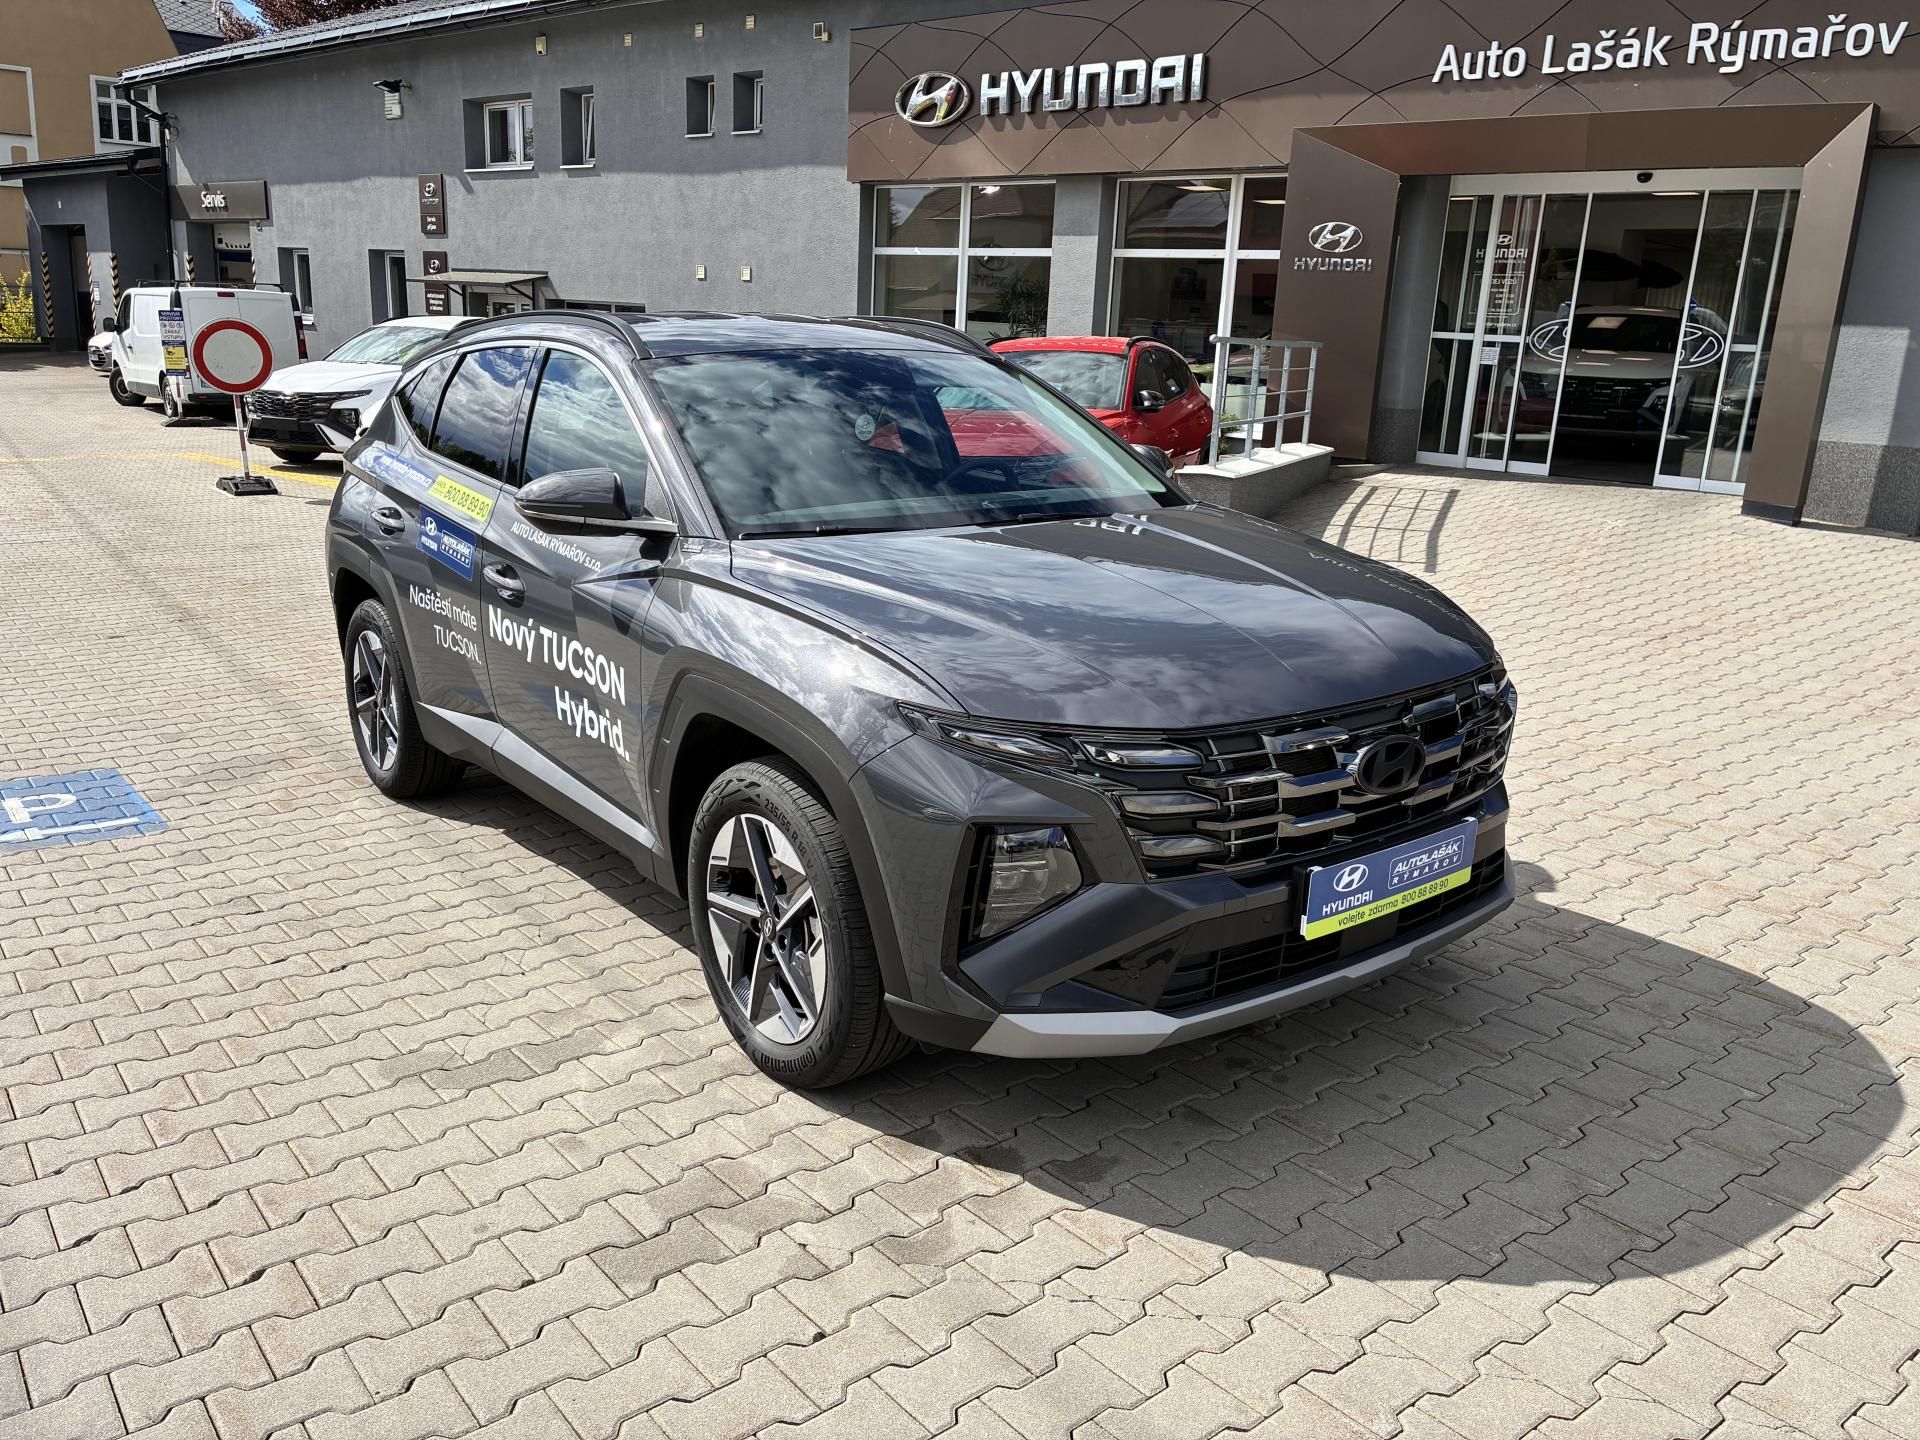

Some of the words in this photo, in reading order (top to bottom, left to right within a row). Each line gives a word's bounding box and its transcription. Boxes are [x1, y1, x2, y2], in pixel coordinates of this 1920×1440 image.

[1431, 40, 1527, 83] Auto
[1541, 26, 1674, 75] Lašák
[1686, 14, 1910, 74] Rýmařov
[980, 53, 1206, 116] HYUNDAI
[200, 190, 226, 208] Servis
[1294, 257, 1373, 272] HYUNDAI
[1476, 248, 1529, 258] HUNDAI
[444, 485, 460, 502] 800
[457, 491, 470, 507] 88
[467, 496, 480, 512] 89
[477, 501, 490, 518] 90
[510, 521, 530, 538] AUTO
[548, 537, 587, 564] RÝMAŘOV
[584, 556, 601, 572] s.r.o.
[409, 584, 452, 618] Naštěstí
[452, 604, 477, 631] máte
[433, 624, 482, 665] TUCSON.
[488, 604, 536, 663] Nový
[539, 625, 626, 707] TUCSON
[554, 685, 630, 763] Hybrid.
[764, 798, 792, 833] 235/55
[1392, 854, 1459, 885] RÝMAŘOV
[1393, 841, 1461, 874] AUTOLAŠÁK
[1322, 889, 1374, 916] HYUNDAI
[1338, 910, 1366, 927] volejte
[1368, 899, 1399, 916] zdarma
[1401, 891, 1417, 905] 800
[1417, 887, 1428, 899] 88
[1428, 883, 1438, 896] 89
[1439, 878, 1449, 890] 90
[760, 1045, 817, 1074] Continental
